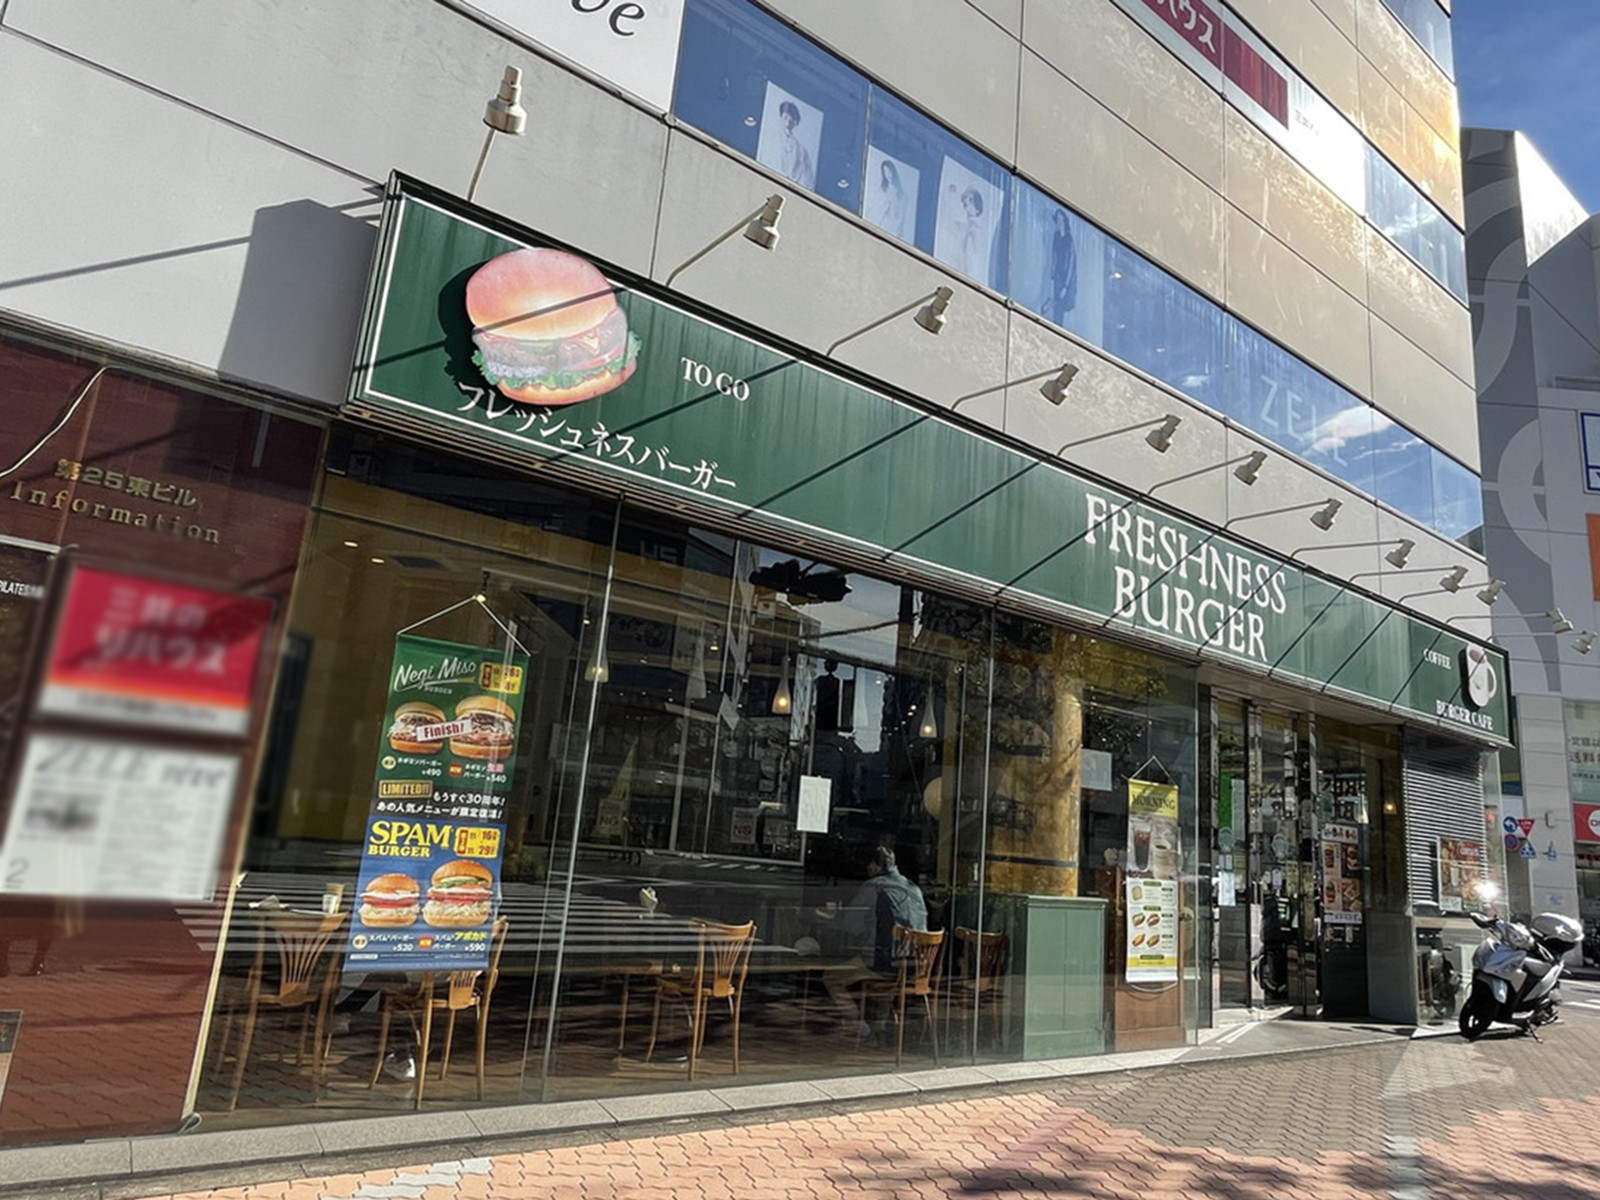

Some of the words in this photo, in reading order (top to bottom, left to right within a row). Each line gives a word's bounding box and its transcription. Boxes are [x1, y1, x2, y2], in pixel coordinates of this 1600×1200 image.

[681, 357, 713, 387] TO
[715, 371, 751, 401] GO
[457, 381, 737, 489] フレッシュネスバーガー
[10, 480, 220, 544] Information
[1084, 493, 1286, 614] FRESHNESS
[1113, 566, 1268, 662] BURGER
[394, 664, 435, 690] Negi
[437, 657, 476, 679] Miso
[1423, 648, 1451, 670] COFFEE
[423, 723, 464, 738] Finish!
[1436, 699, 1471, 724] BURGER
[1471, 711, 1494, 730] CAFE
[368, 845, 430, 857] BURGER
[370, 820, 452, 849] SPAM
